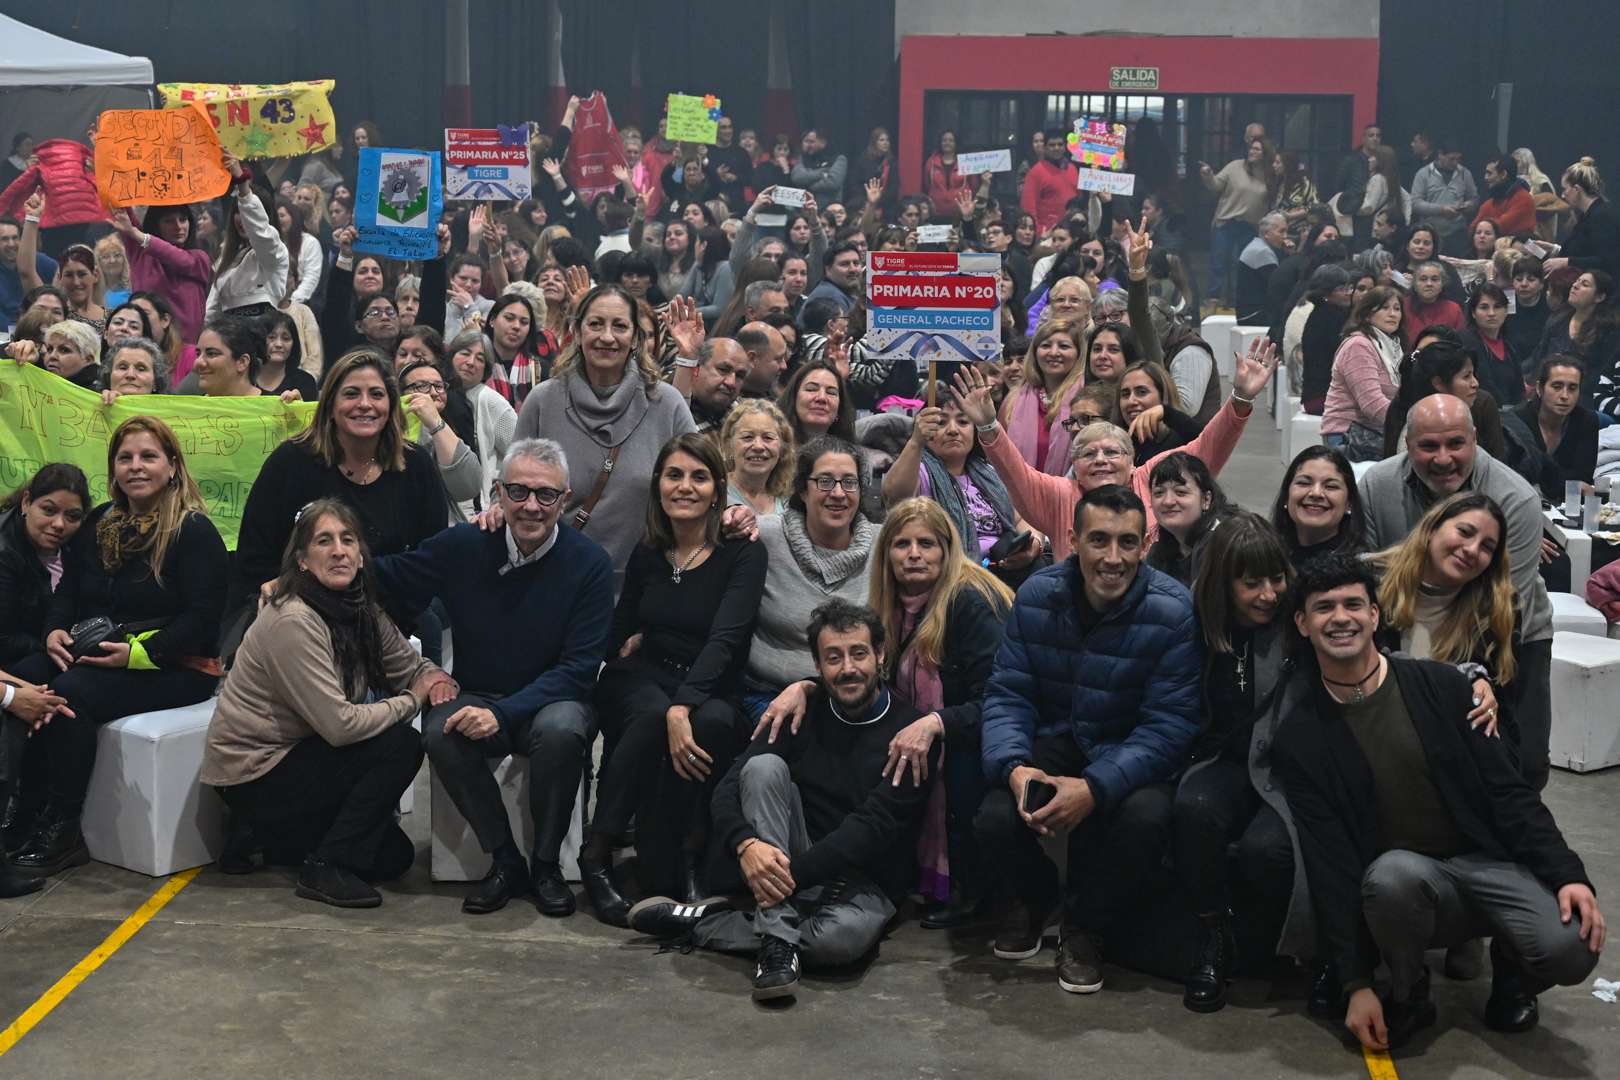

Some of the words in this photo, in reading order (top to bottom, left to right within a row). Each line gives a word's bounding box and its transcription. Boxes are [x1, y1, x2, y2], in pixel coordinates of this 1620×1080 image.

[1112, 69, 1156, 81] SALIDA
[260, 98, 295, 124] 43
[450, 151, 499, 159] PRIMARIA
[473, 169, 503, 177] TIGRE
[873, 285, 951, 298] PRIMARIA
[955, 286, 994, 299] N°20
[877, 314, 931, 325] GENERAL
[935, 316, 990, 326] PACHECO
